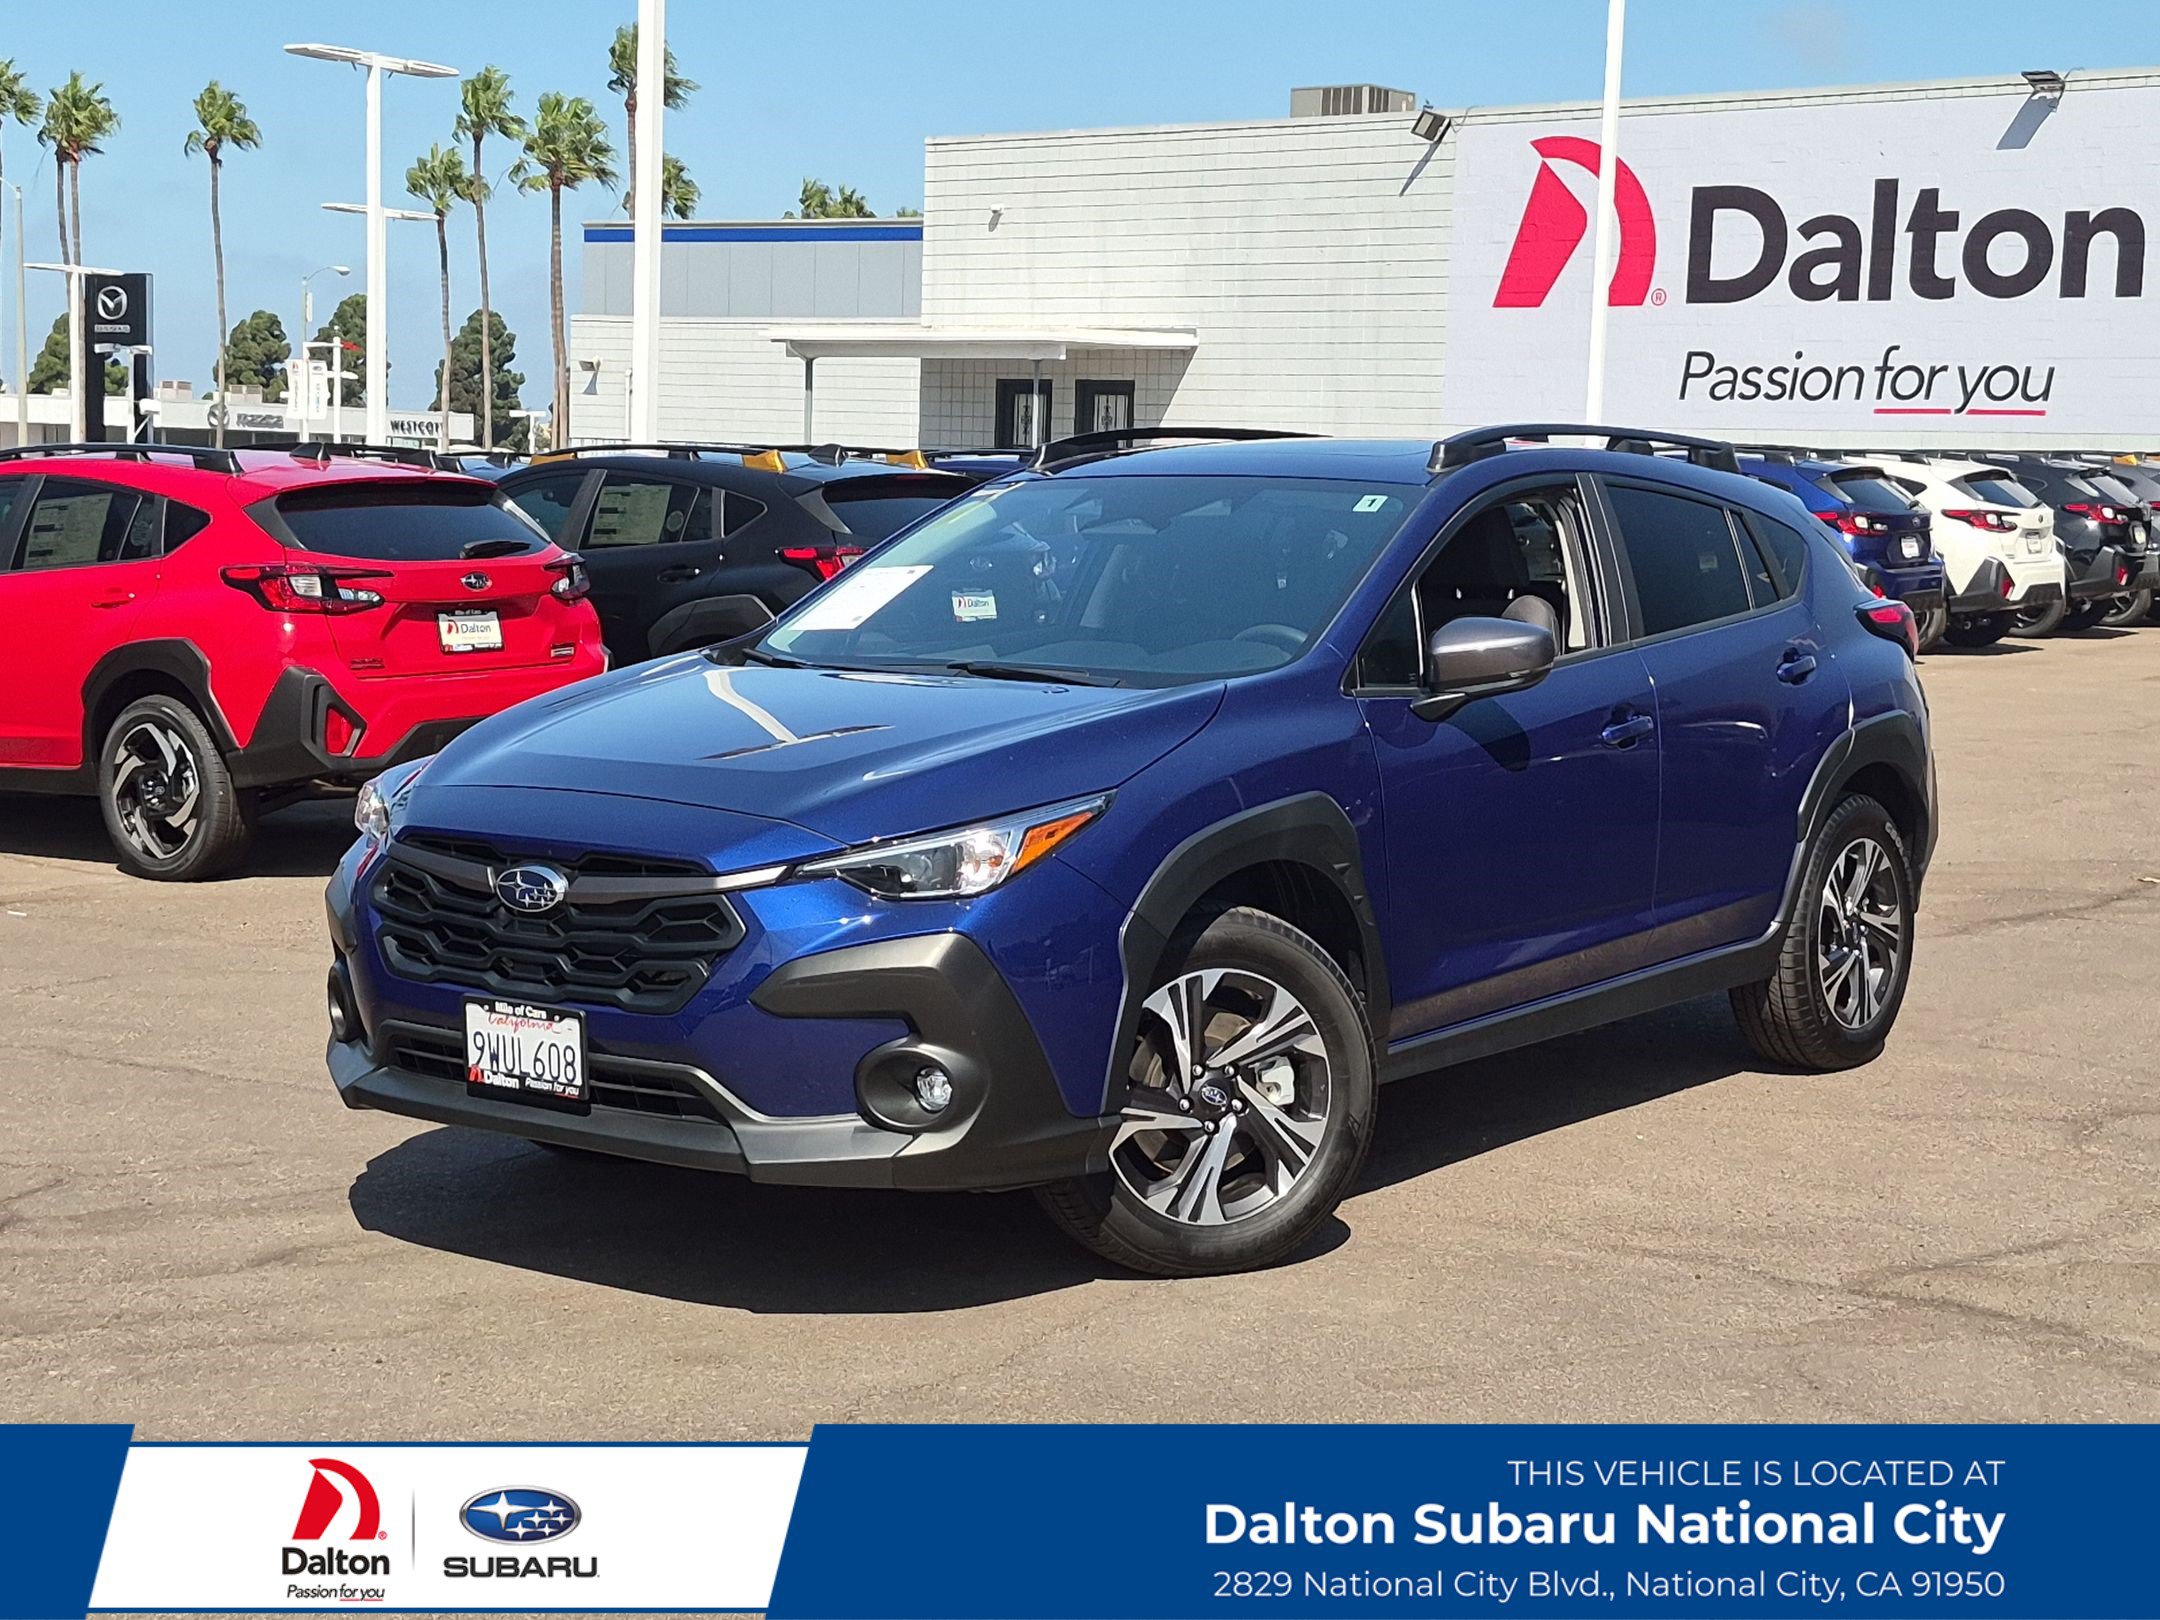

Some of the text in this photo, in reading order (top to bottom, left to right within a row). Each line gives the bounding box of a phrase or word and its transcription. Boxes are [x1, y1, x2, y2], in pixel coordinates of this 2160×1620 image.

[1686, 178, 2146, 304] Dalton
[1679, 345, 2055, 415] Passion for you
[495, 1001, 546, 1019] Mile of Cars
[473, 1031, 576, 1083] 9WUL608
[484, 1070, 519, 1088] Dalton
